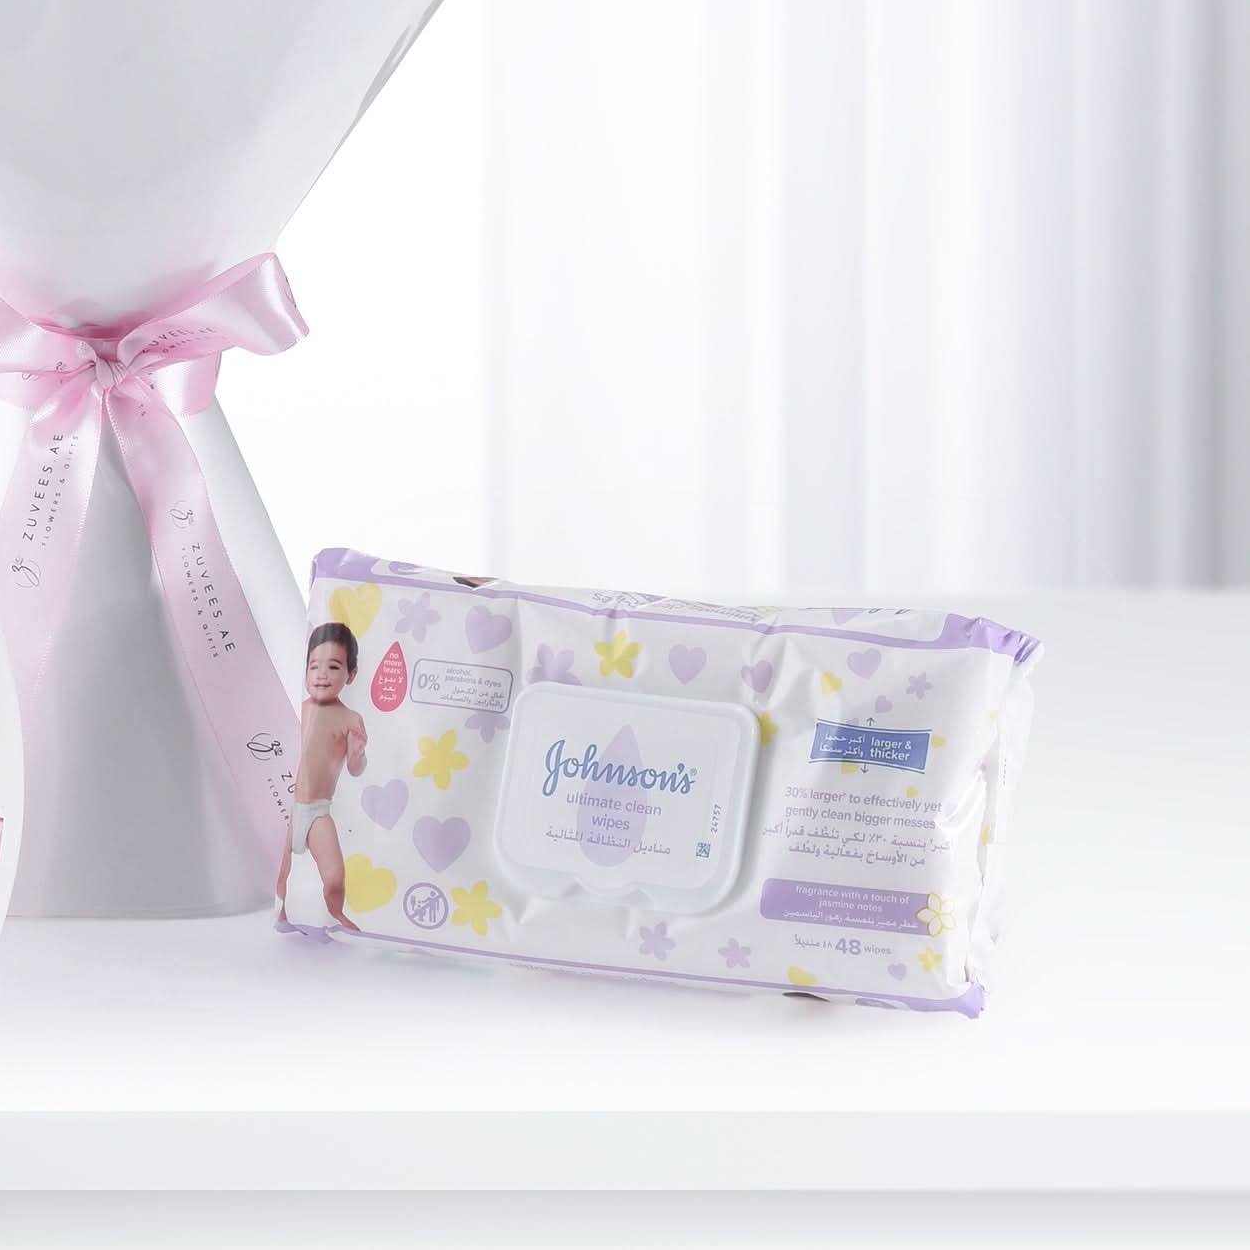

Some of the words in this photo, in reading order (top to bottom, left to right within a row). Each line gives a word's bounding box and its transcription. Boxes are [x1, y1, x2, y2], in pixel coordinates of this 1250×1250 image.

[418, 673, 440, 691] 0%
[871, 737, 902, 750] larger
[905, 740, 912, 750] &
[870, 748, 910, 761] thicker
[566, 791, 623, 812] ultimate
[625, 800, 662, 817] clean
[785, 787, 808, 799] 30%
[849, 794, 861, 804] to
[863, 794, 922, 812] effectively
[924, 801, 942, 813] yet
[591, 814, 630, 831] wipes
[785, 805, 819, 821] gently
[821, 808, 851, 822] clean
[854, 811, 892, 827] bigger
[894, 817, 936, 830] messes
[796, 886, 839, 897] fragrance
[841, 891, 861, 900] with
[871, 893, 897, 904] touch
[899, 896, 910, 904] of
[818, 899, 855, 910] jasmine
[857, 903, 883, 913] notes
[835, 938, 861, 955] 48
[864, 944, 892, 955] wipes
